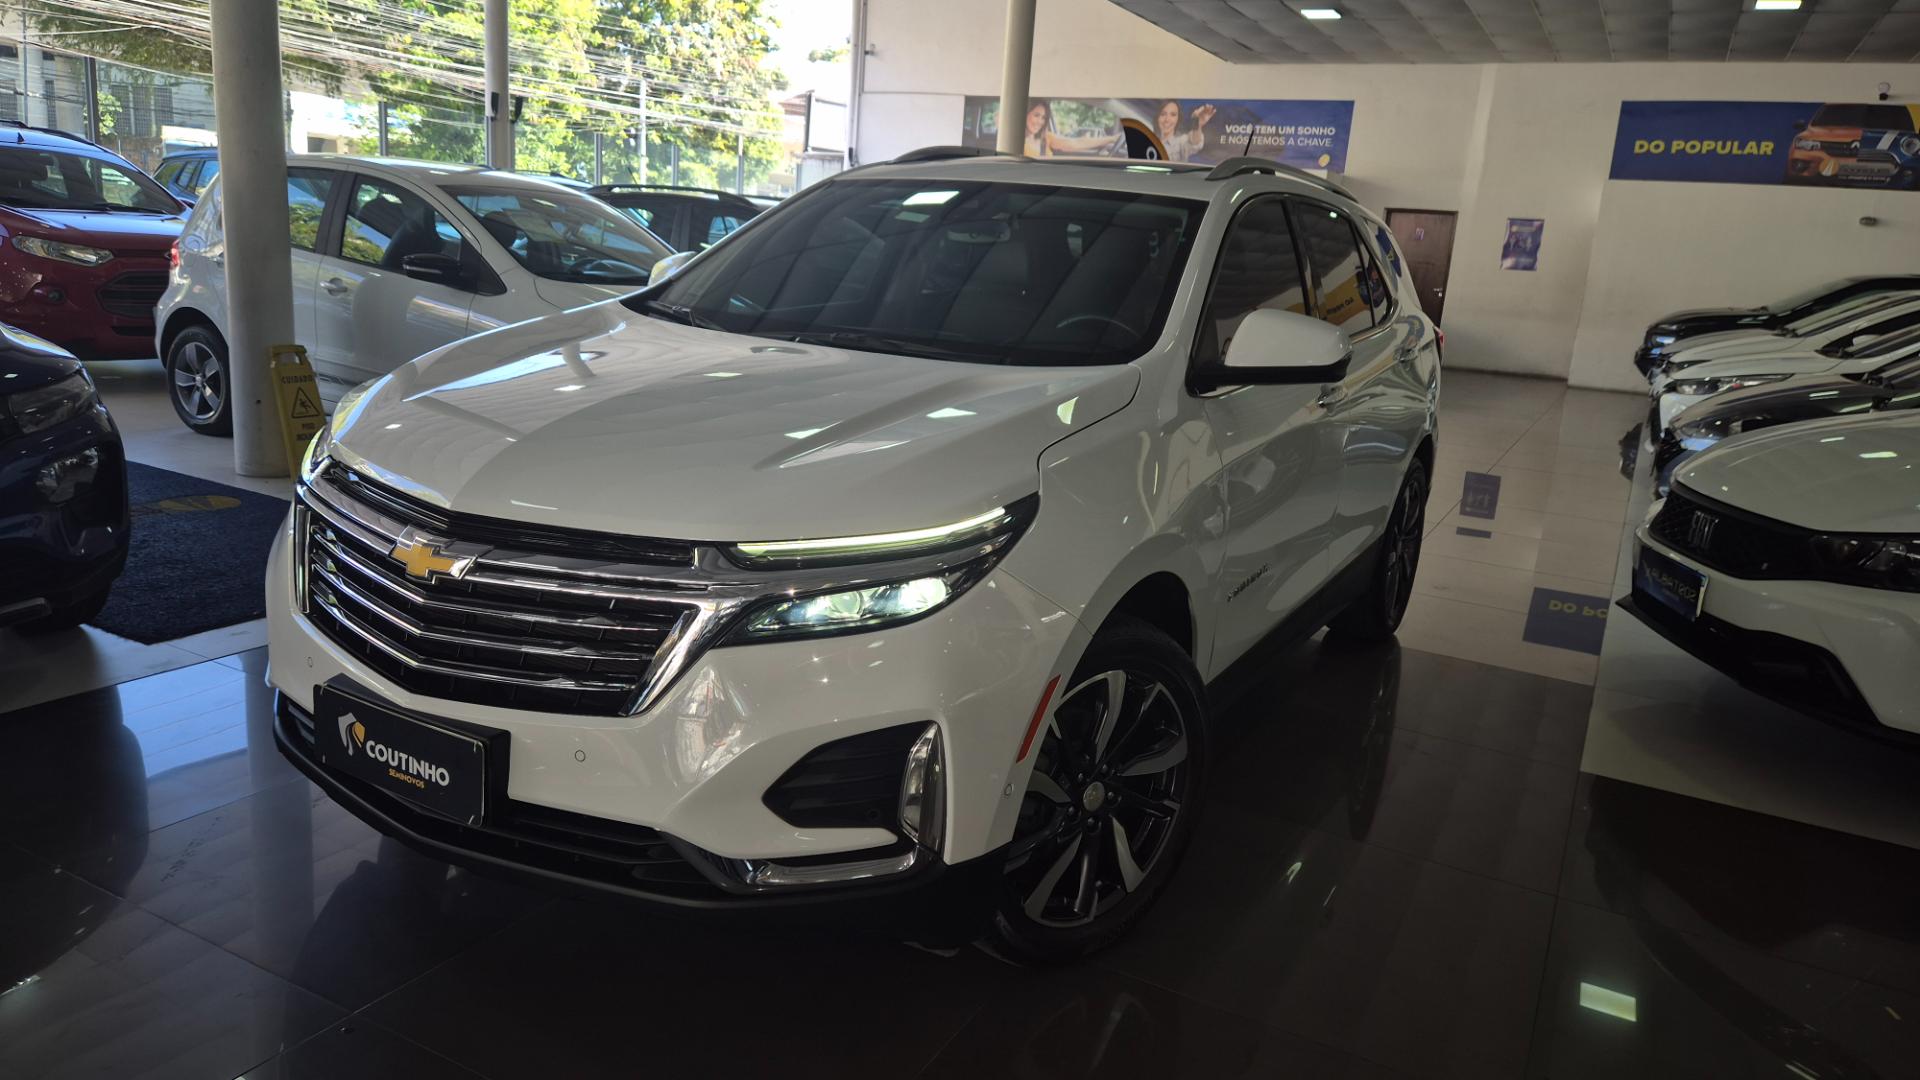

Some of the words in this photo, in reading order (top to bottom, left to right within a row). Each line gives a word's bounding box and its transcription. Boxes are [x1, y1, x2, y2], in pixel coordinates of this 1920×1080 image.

[1225, 123, 1253, 134] VOCÊ
[1254, 125, 1276, 134] TEM
[1278, 125, 1295, 134] UM
[1297, 126, 1336, 136] SONHO
[1220, 135, 1226, 144] E
[1228, 134, 1249, 145] NÓS
[1252, 136, 1284, 145] TEMOS
[1287, 137, 1295, 145] A
[1633, 139, 1665, 154] DO
[1671, 139, 1775, 156] POPULAR
[366, 740, 450, 787] COUTINHO
